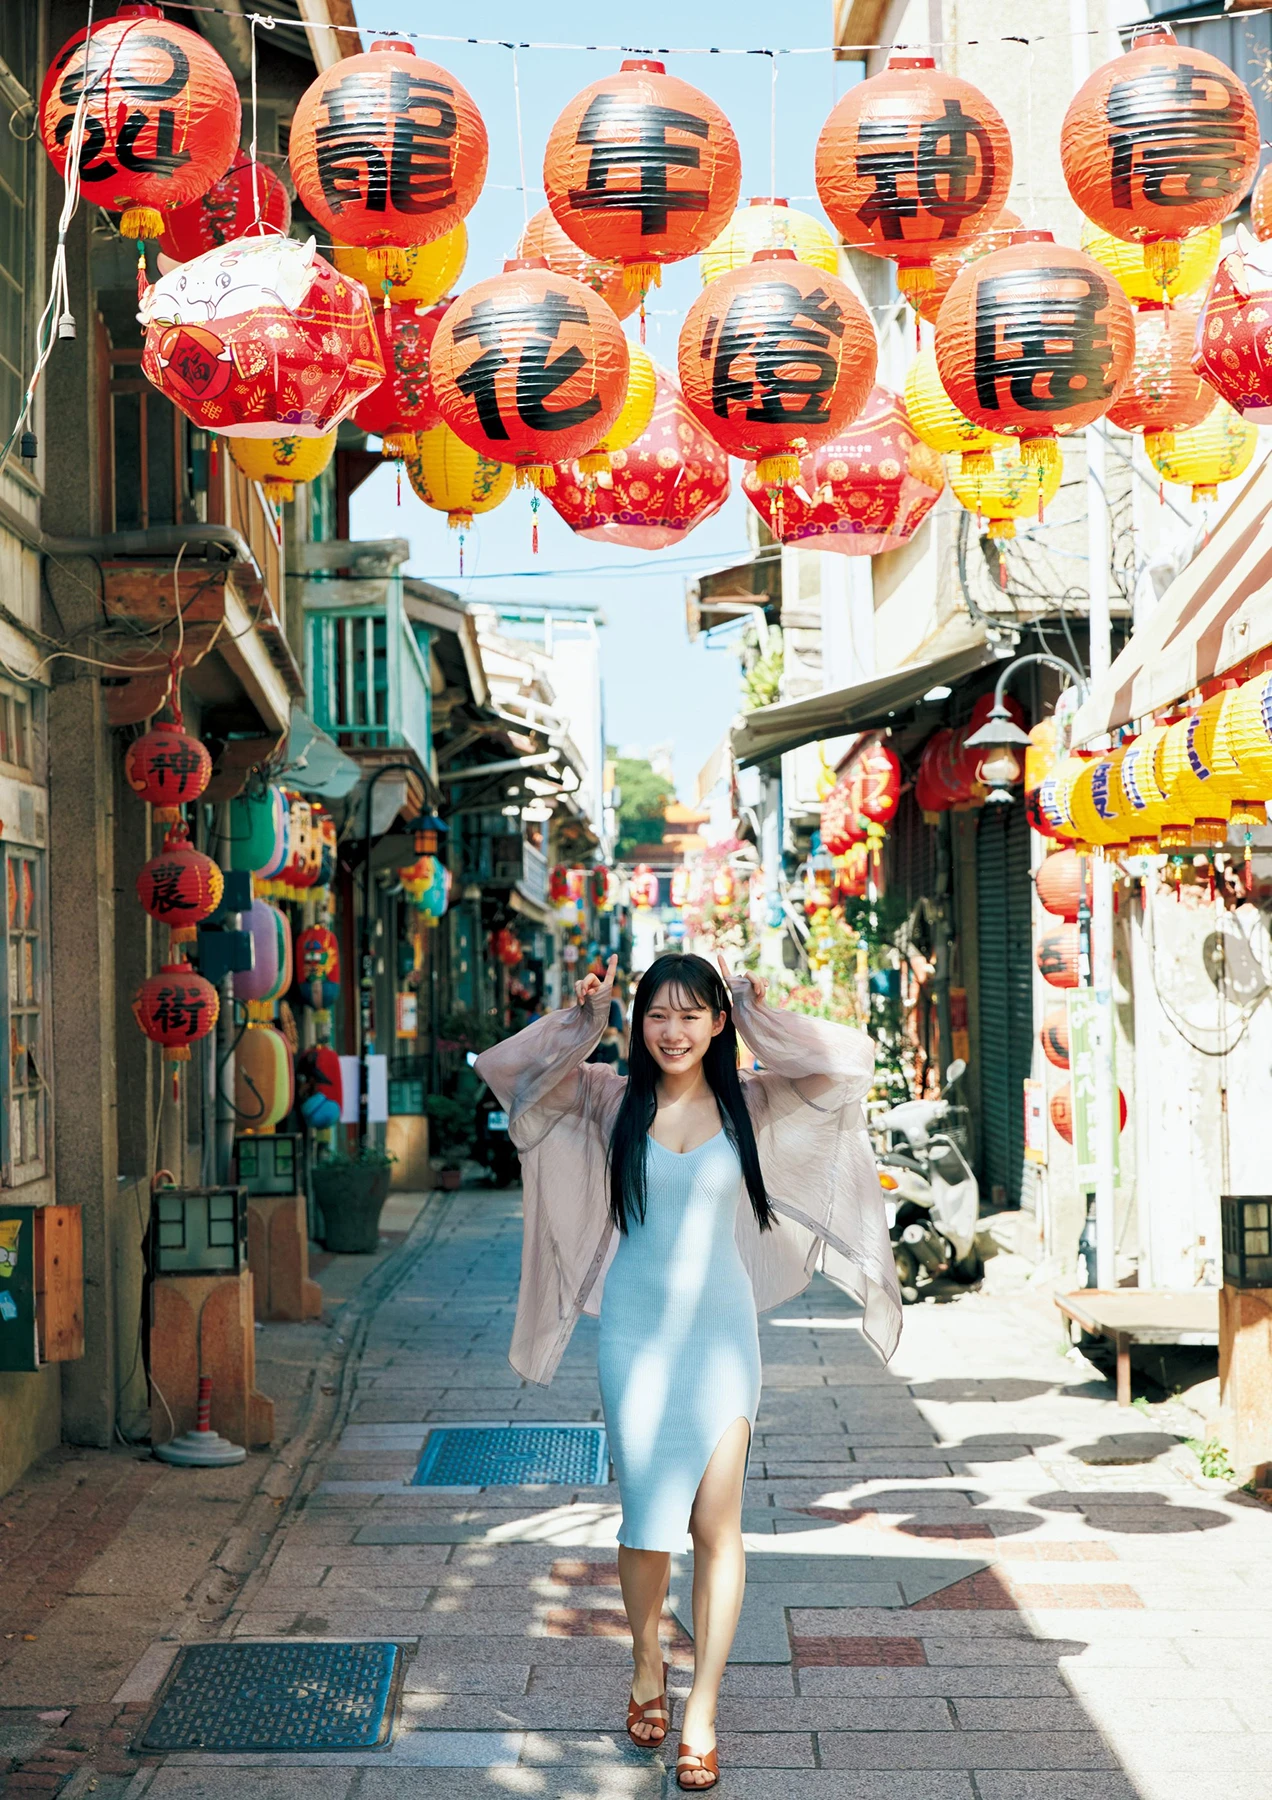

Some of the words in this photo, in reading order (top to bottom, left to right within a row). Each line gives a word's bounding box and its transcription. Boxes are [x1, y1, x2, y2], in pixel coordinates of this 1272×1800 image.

[56, 35, 191, 103] 20
[55, 107, 191, 182] 24
[315, 70, 459, 215] 龍
[568, 93, 709, 236] 年
[853, 98, 995, 241] 神
[177, 344, 210, 384] 福
[452, 290, 601, 441] 花
[149, 742, 199, 793] 神
[150, 864, 197, 914] 農
[152, 985, 204, 1036] 街
